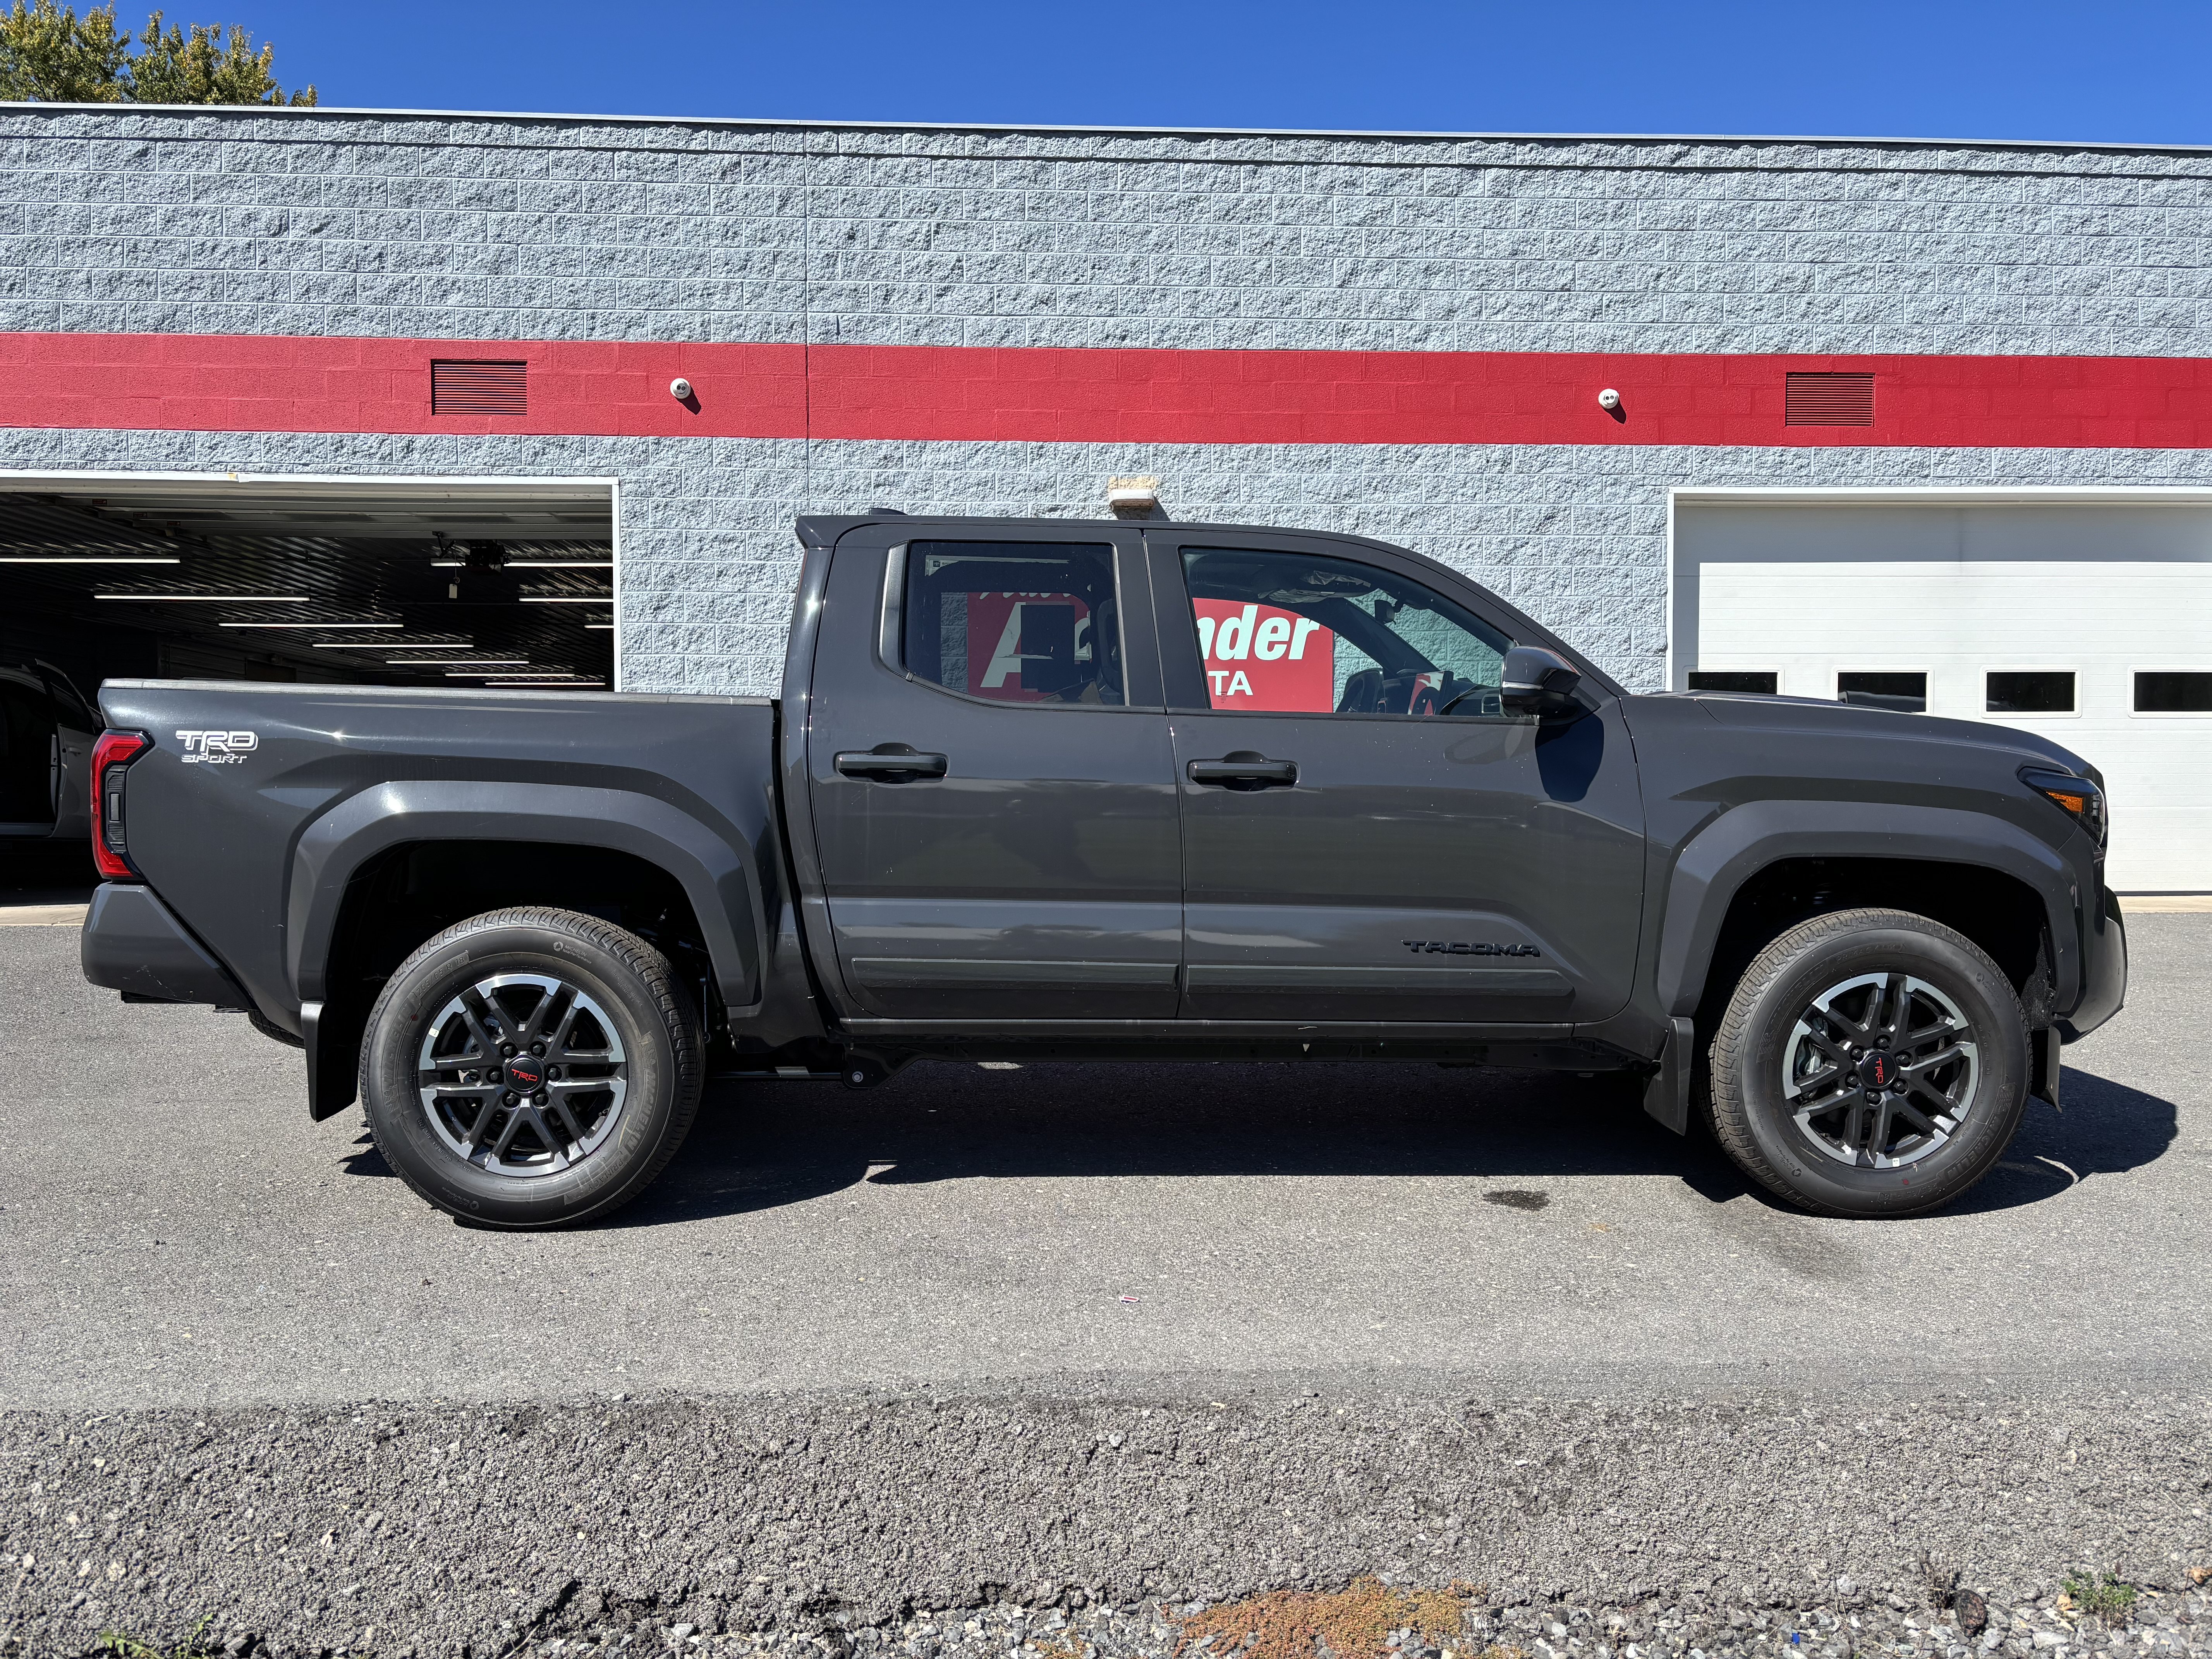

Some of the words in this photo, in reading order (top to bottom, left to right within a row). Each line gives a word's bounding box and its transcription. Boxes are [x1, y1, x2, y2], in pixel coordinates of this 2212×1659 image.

[175, 730, 258, 756] TRD
[181, 754, 247, 763] SPORT
[565, 945, 587, 956] MICHELIN
[1401, 939, 1540, 957] TACOMA
[416, 969, 443, 996] 265/65
[455, 957, 464, 967] 18
[512, 1068, 538, 1081] TRD
[629, 1071, 656, 1151] MICHELIN
[587, 1158, 624, 1192] PRIMACY
